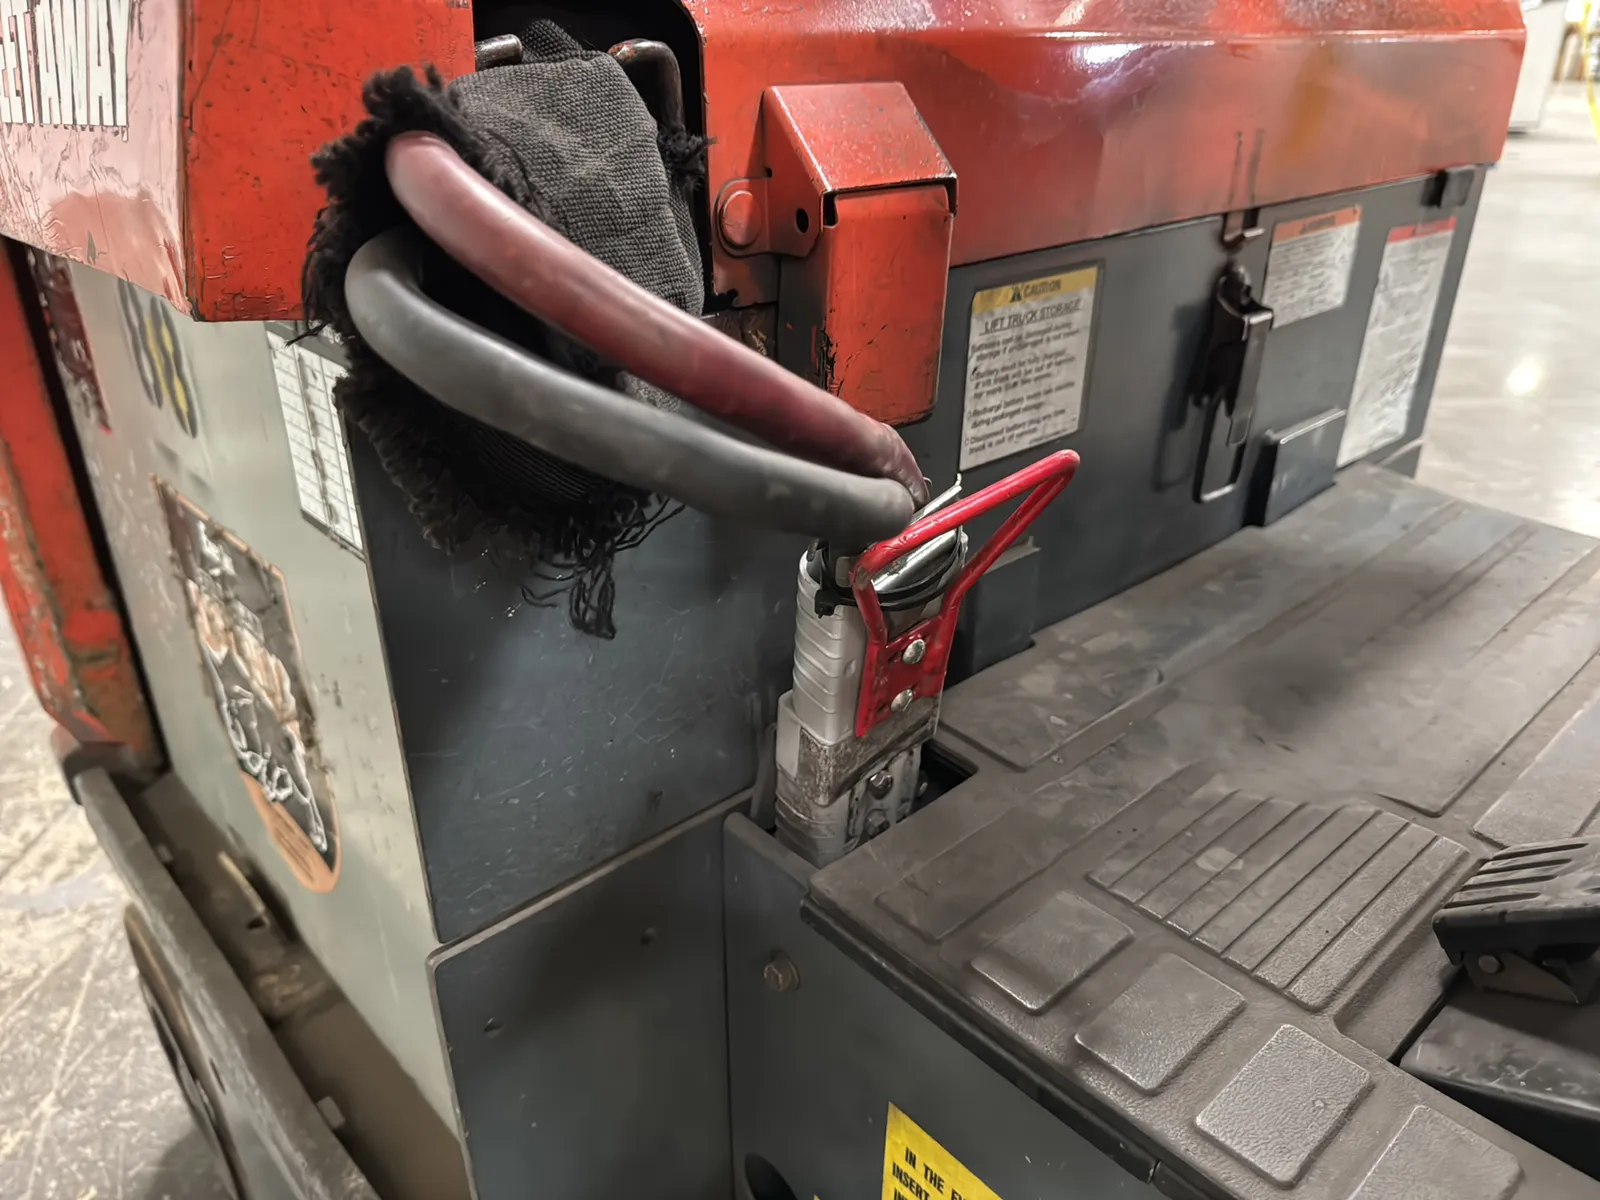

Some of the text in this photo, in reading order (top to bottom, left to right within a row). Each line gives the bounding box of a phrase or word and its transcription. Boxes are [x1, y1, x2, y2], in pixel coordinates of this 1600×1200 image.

[34, 0, 129, 126] AWAY
[1024, 280, 1061, 296] CAUTION
[984, 318, 1005, 332] LIFT
[1007, 310, 1037, 326] TRUCK
[892, 1161, 931, 1200] INSERT
[905, 1147, 917, 1170] IN
[923, 1162, 945, 1195] THE
